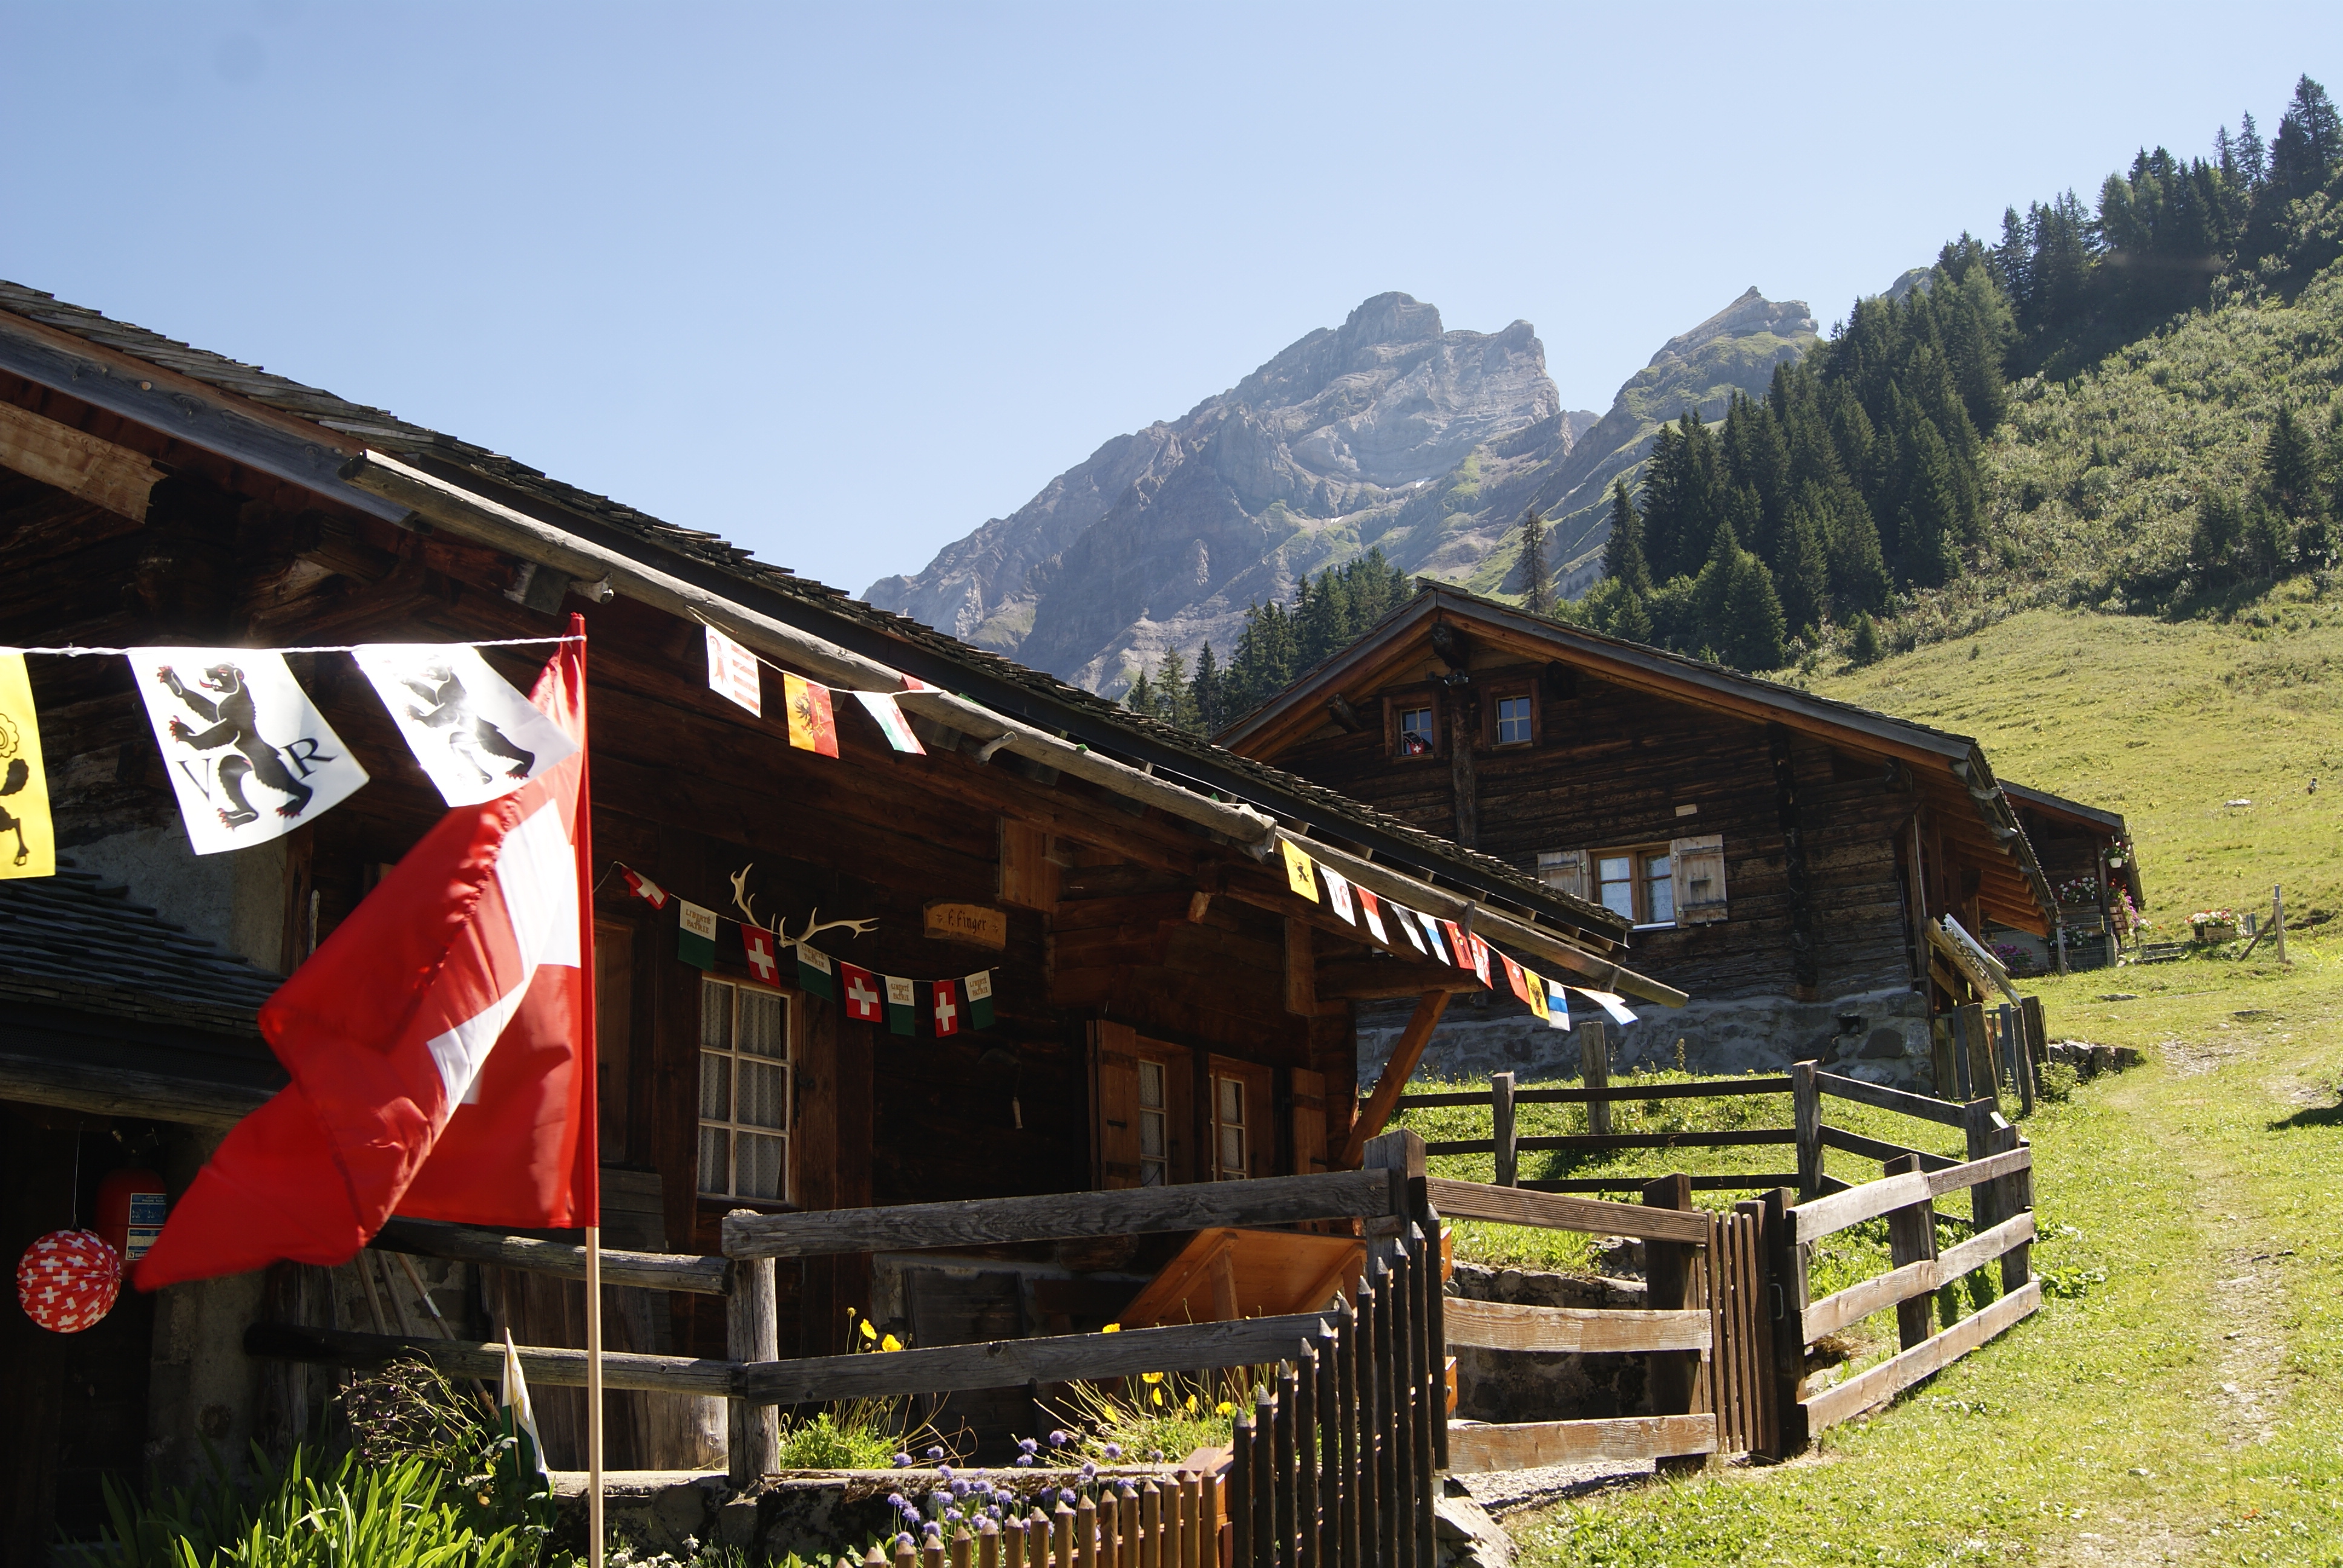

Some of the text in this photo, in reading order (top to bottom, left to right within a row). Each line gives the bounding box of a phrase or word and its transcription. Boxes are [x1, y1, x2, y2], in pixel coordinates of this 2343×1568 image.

[175, 737, 338, 802] V R
[686, 909, 711, 924] LIBERTÉ
[957, 910, 987, 934] Finger
[686, 919, 709, 934] PATRIE
[804, 953, 825, 968] PATRIE
